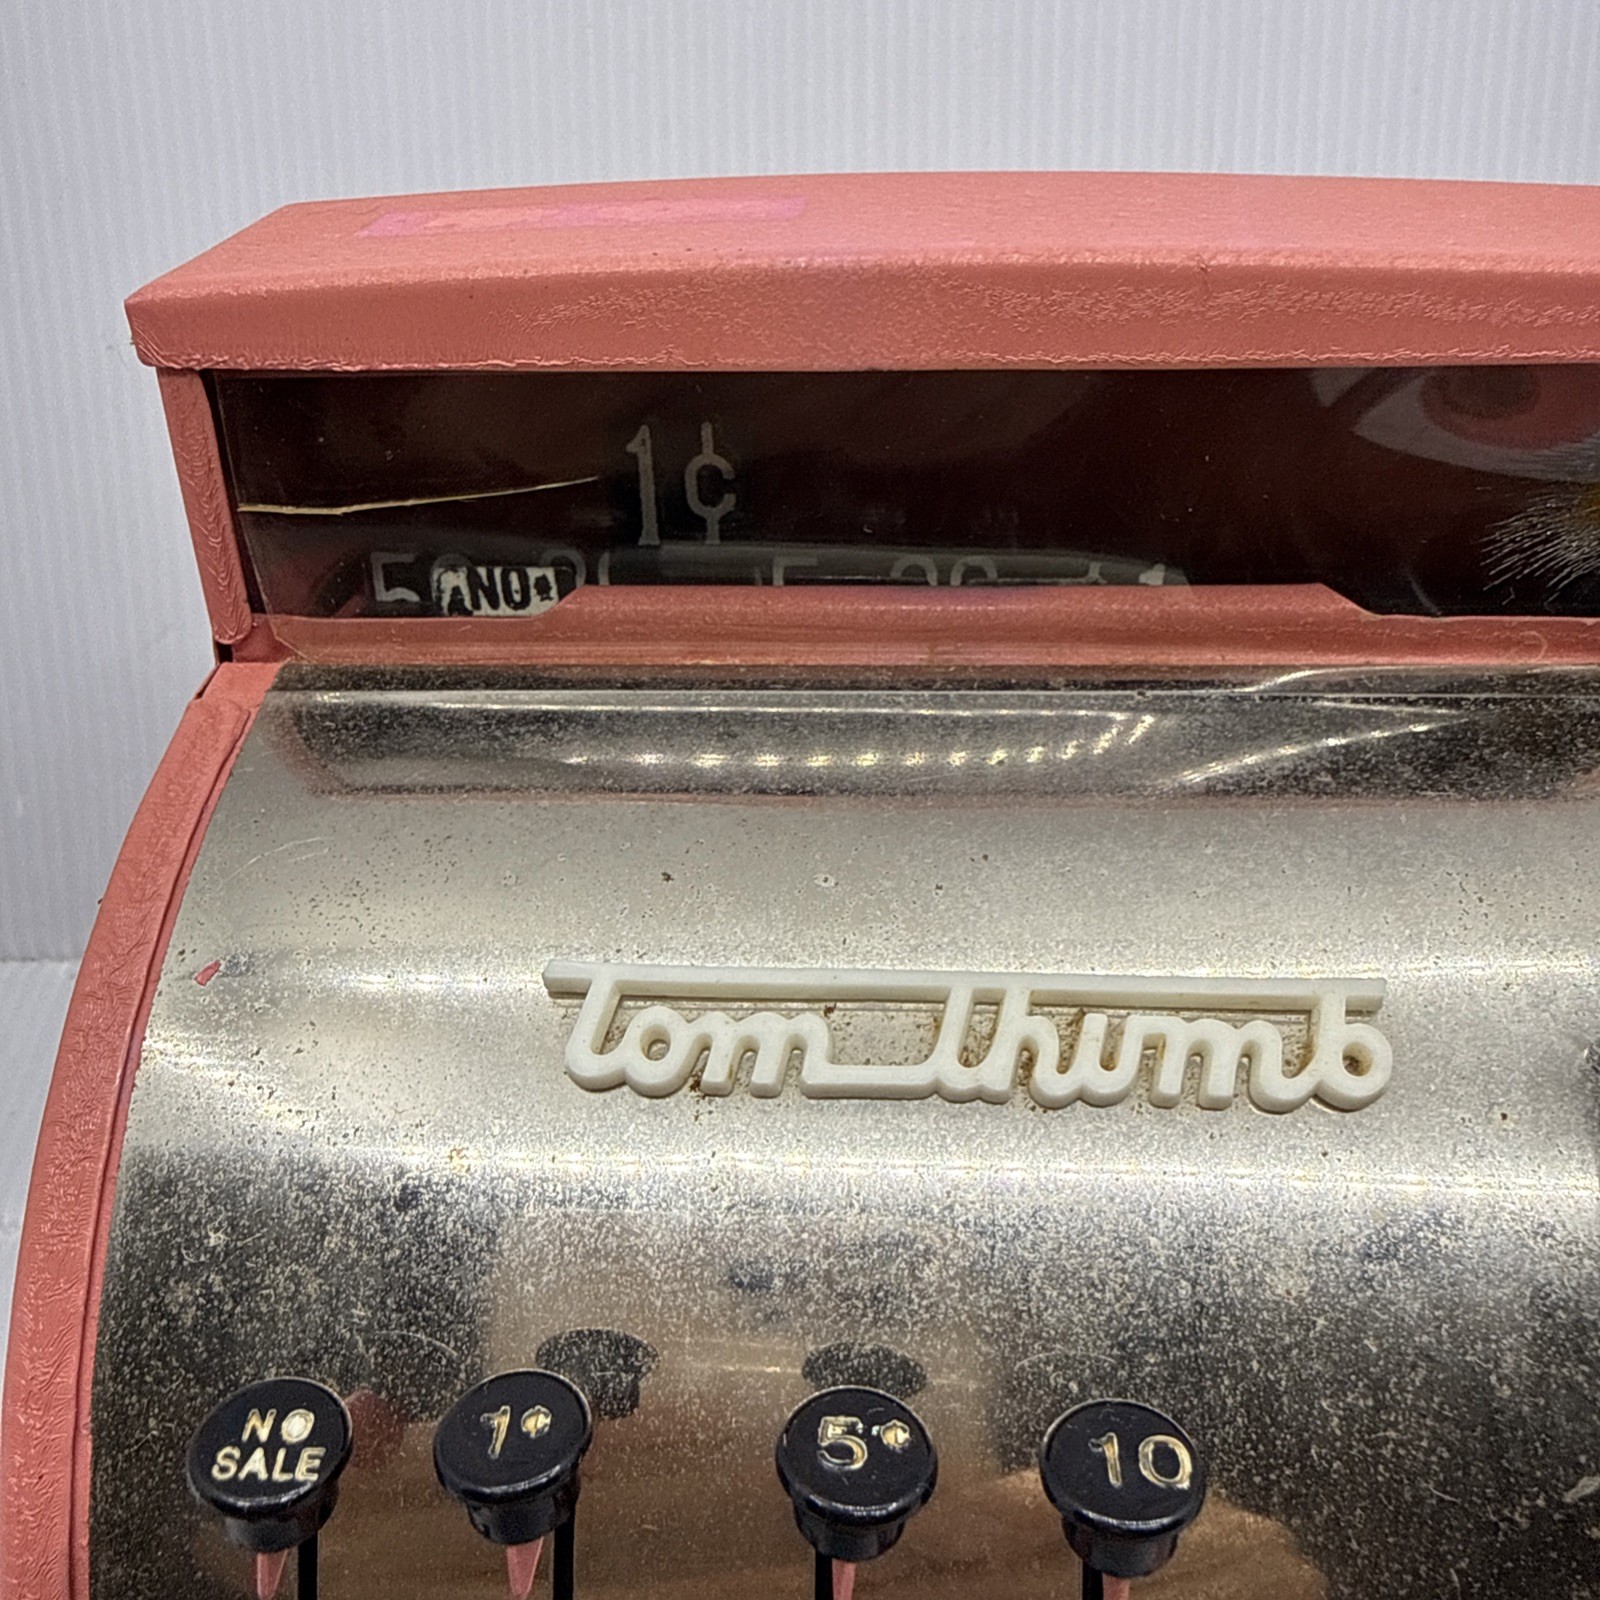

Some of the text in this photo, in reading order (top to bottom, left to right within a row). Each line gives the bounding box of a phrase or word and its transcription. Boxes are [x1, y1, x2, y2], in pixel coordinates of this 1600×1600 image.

[242, 1408, 316, 1444] NO
[210, 1446, 327, 1482] SALE
[1088, 1432, 1194, 1490] 10
